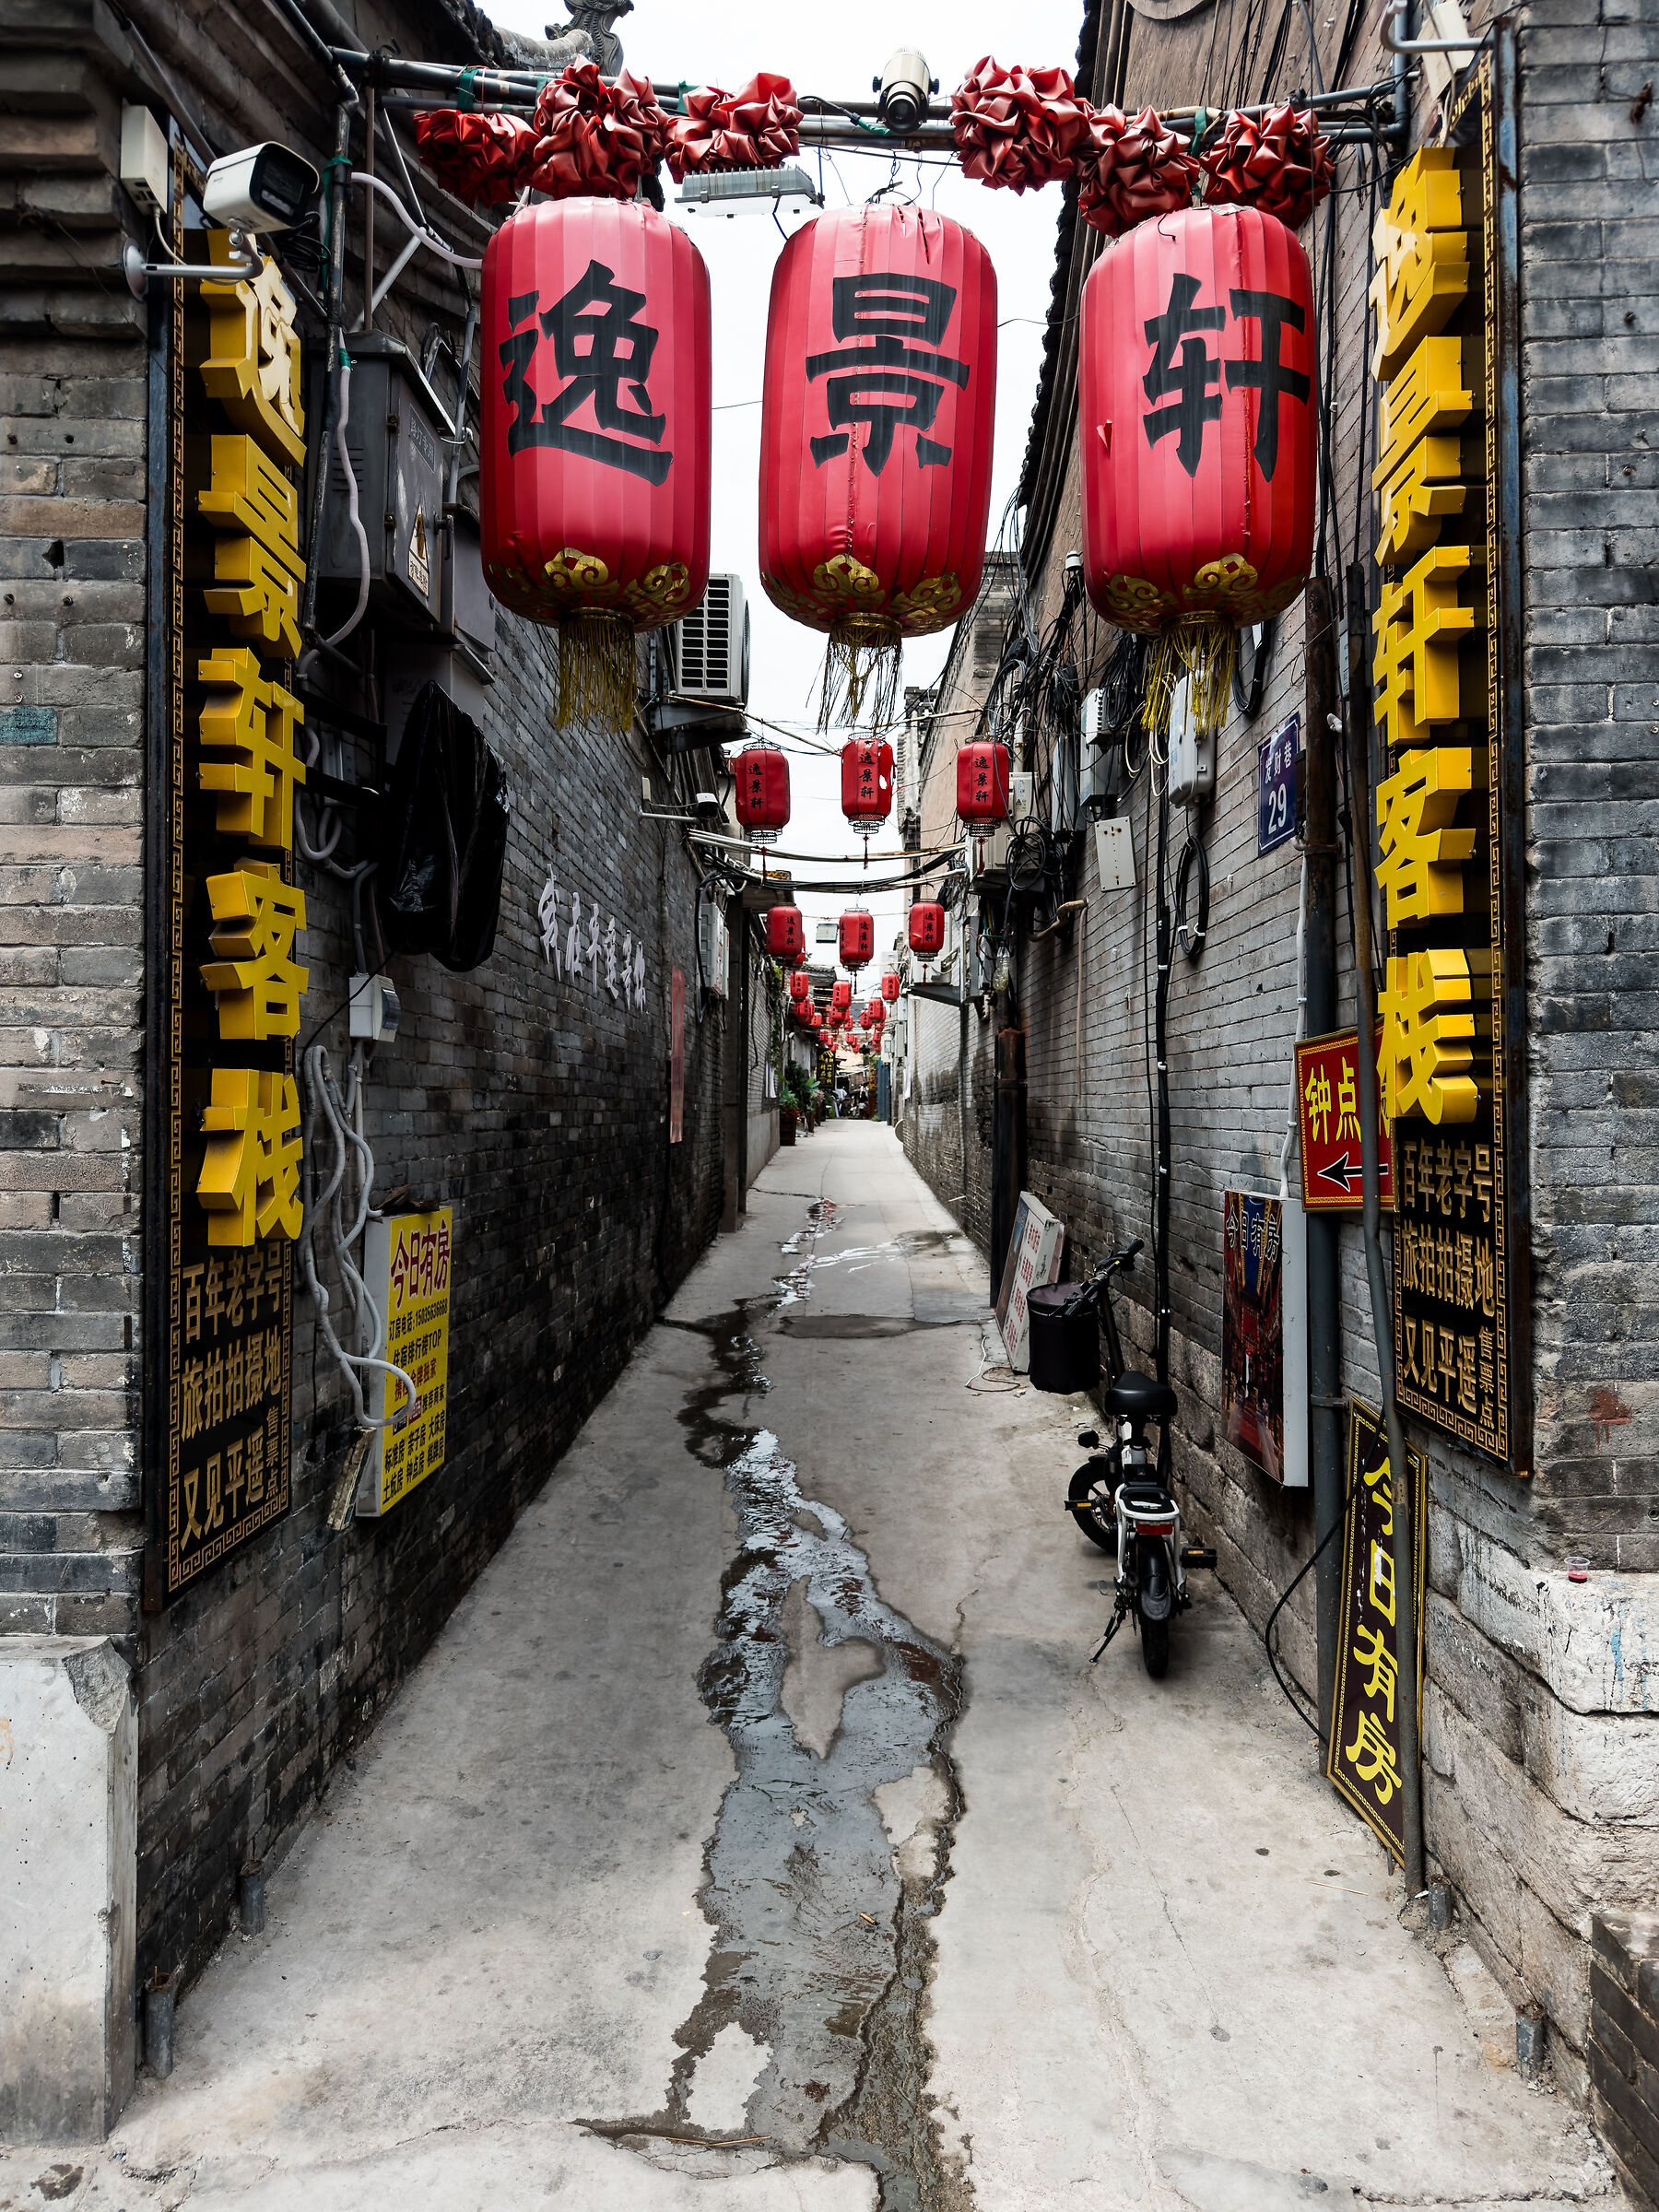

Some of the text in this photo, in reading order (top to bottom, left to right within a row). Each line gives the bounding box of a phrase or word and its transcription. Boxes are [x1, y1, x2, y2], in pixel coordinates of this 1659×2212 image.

[499, 261, 1312, 487] 逸 景 轩
[1370, 147, 1477, 1124] 逸景轩客栈
[748, 762, 764, 809] 逸景轩
[859, 751, 876, 800] 逸景轩
[974, 756, 990, 803] 逸景轩
[1268, 783, 1288, 835] 29
[859, 921, 869, 951] 逸景轩
[924, 912, 934, 942] 逸景轩
[1305, 1055, 1390, 1146] 钟点
[1403, 1137, 1493, 1223] 百年老字号
[390, 1218, 451, 1310] 今日有房
[1226, 1205, 1281, 1263] 今日有房
[1402, 1218, 1496, 1317] 旅拍拍摄地
[182, 1241, 283, 1345] 百年老字号
[182, 1324, 282, 1442] 旅拍拍摄地
[1403, 1314, 1477, 1415] 又见平遥
[1478, 1325, 1495, 1430] 售票点
[180, 1425, 265, 1552] 又见平遥
[265, 1406, 279, 1500] 售票点
